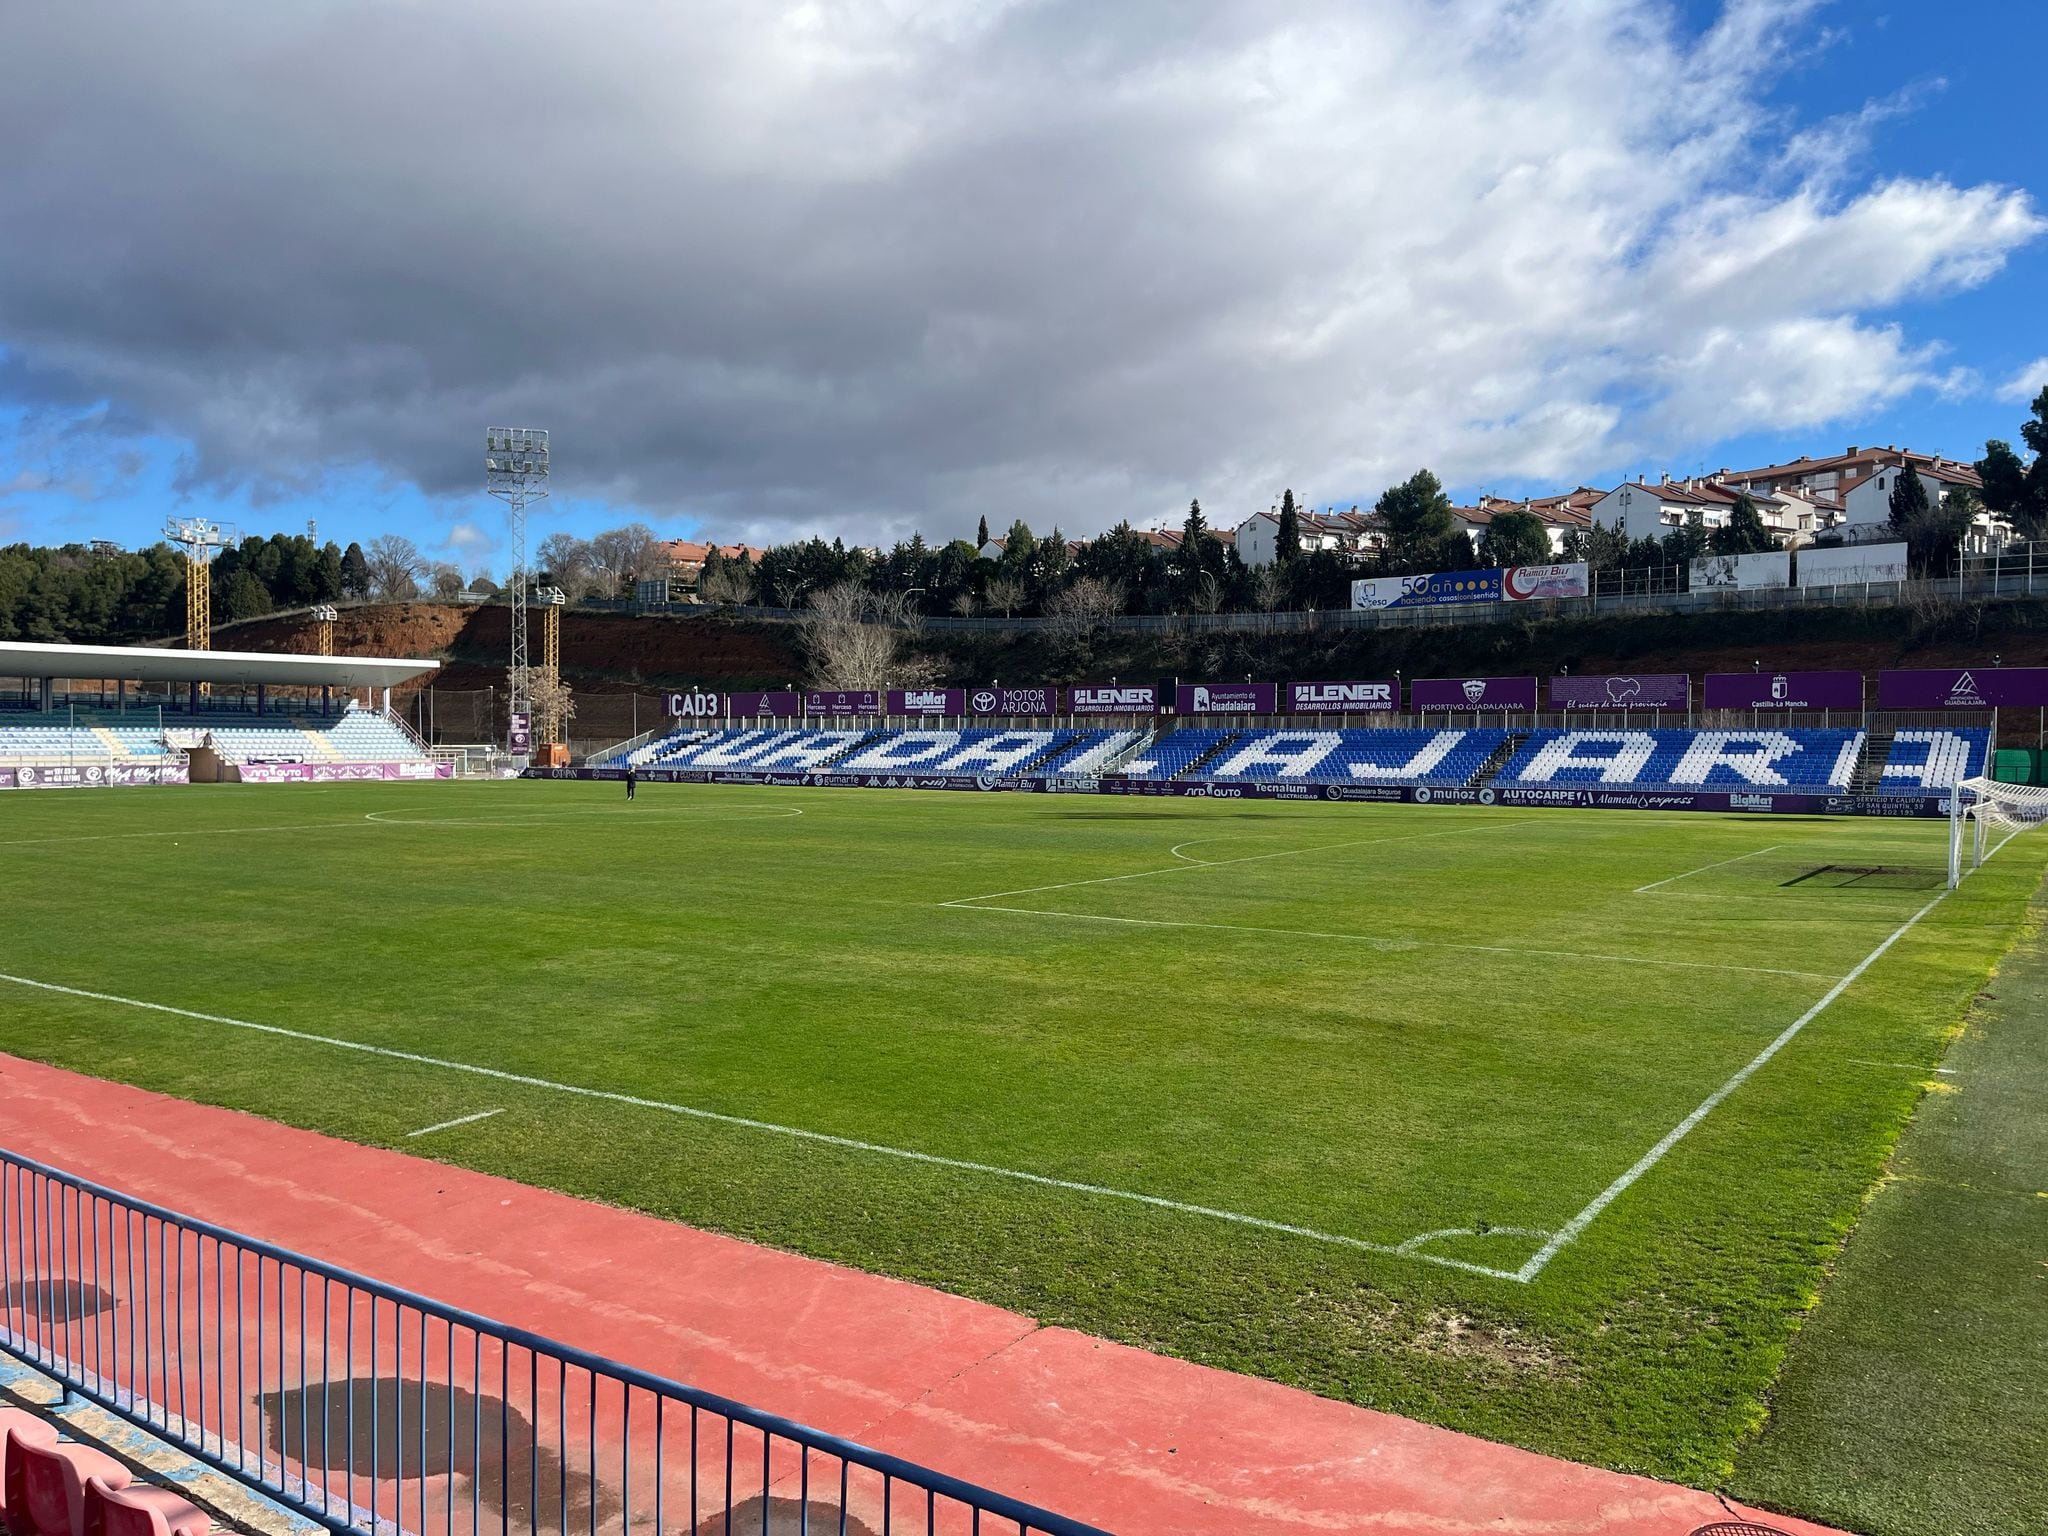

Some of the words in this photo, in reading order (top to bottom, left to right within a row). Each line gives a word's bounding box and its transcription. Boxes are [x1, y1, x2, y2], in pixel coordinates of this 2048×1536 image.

[1401, 576, 1430, 596] 50
[1401, 594, 1437, 605] haciendo
[905, 691, 947, 709] BigMat
[1003, 690, 1046, 702] MOTOR
[1211, 692, 1247, 701] Ayuntamiento
[1248, 691, 1256, 700] de
[671, 693, 718, 717] CAD3
[1001, 702, 1048, 713] ARJONA
[1211, 700, 1256, 711] Guadalajara
[1295, 703, 1341, 711] DESARROLLOS
[1342, 701, 1393, 710] INMOBILIARIOS
[1466, 703, 1524, 711] GUADALAJARA
[1602, 700, 1612, 708] de
[1629, 701, 1668, 710] provincia
[772, 776, 800, 786] Domino's
[824, 774, 859, 786] gumarfe
[1254, 783, 1307, 793] Tecnalum
[1343, 787, 1376, 796] Guadalajara
[1377, 788, 1401, 797] Seguros
[1433, 788, 1475, 800] muñoz
[1502, 790, 1575, 801] AUTOCARPE
[1597, 794, 1637, 805] Alameda
[1649, 796, 1694, 807] express
[1729, 794, 1773, 806] BigMat
